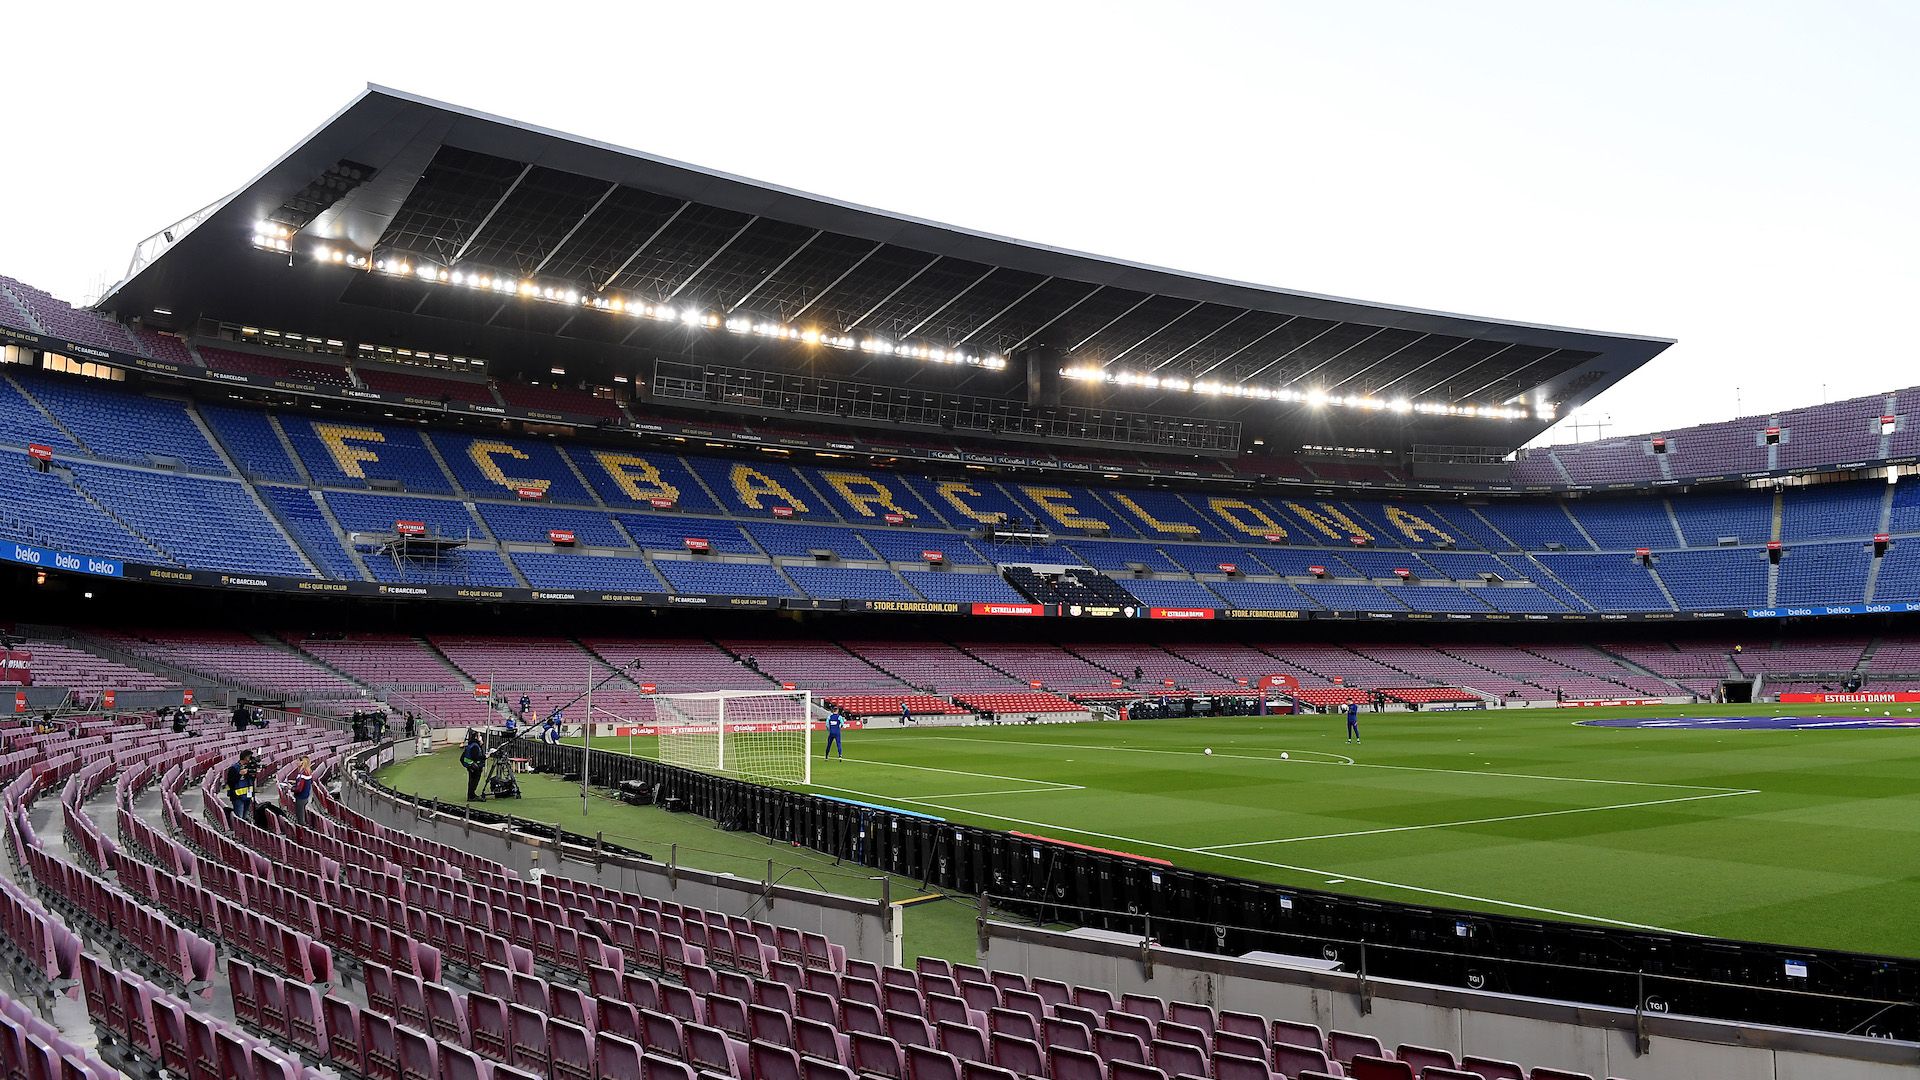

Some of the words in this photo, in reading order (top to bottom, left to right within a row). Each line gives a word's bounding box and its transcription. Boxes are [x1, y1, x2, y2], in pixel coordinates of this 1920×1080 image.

[24, 333, 39, 342] CLUB
[81, 346, 110, 358] BARCELONA
[220, 374, 248, 382] BARCELONA
[938, 452, 960, 460] CaixaBank
[970, 454, 993, 462] CaixaBank
[1004, 457, 1026, 465] CaixaBank
[1036, 459, 1058, 468] CaixaBank
[1067, 462, 1089, 470] CaixaBank
[314, 421, 552, 492] FC
[594, 449, 1457, 544] BARCELONA
[15, 545, 41, 563] beko
[55, 553, 80, 570] beko
[88, 559, 114, 575] beko
[150, 570, 161, 578] MÉS
[161, 571, 171, 579] QUE
[178, 573, 193, 581] CLUB
[236, 578, 268, 586] BARCELONA
[299, 582, 312, 590] MÉS
[874, 601, 958, 612] STORE.FCBARCELONA.COM
[991, 606, 1016, 614] ESTRELLA
[1826, 606, 1851, 614] beko
[1906, 603, 1920, 611] be
[1231, 610, 1299, 619] STORE.FCBARCELONA.COM
[1825, 694, 1866, 703] ESTRELLA
[1867, 694, 1895, 702] DAMM
[1469, 975, 1480, 984] TGI
[1649, 1002, 1663, 1011] TGI
